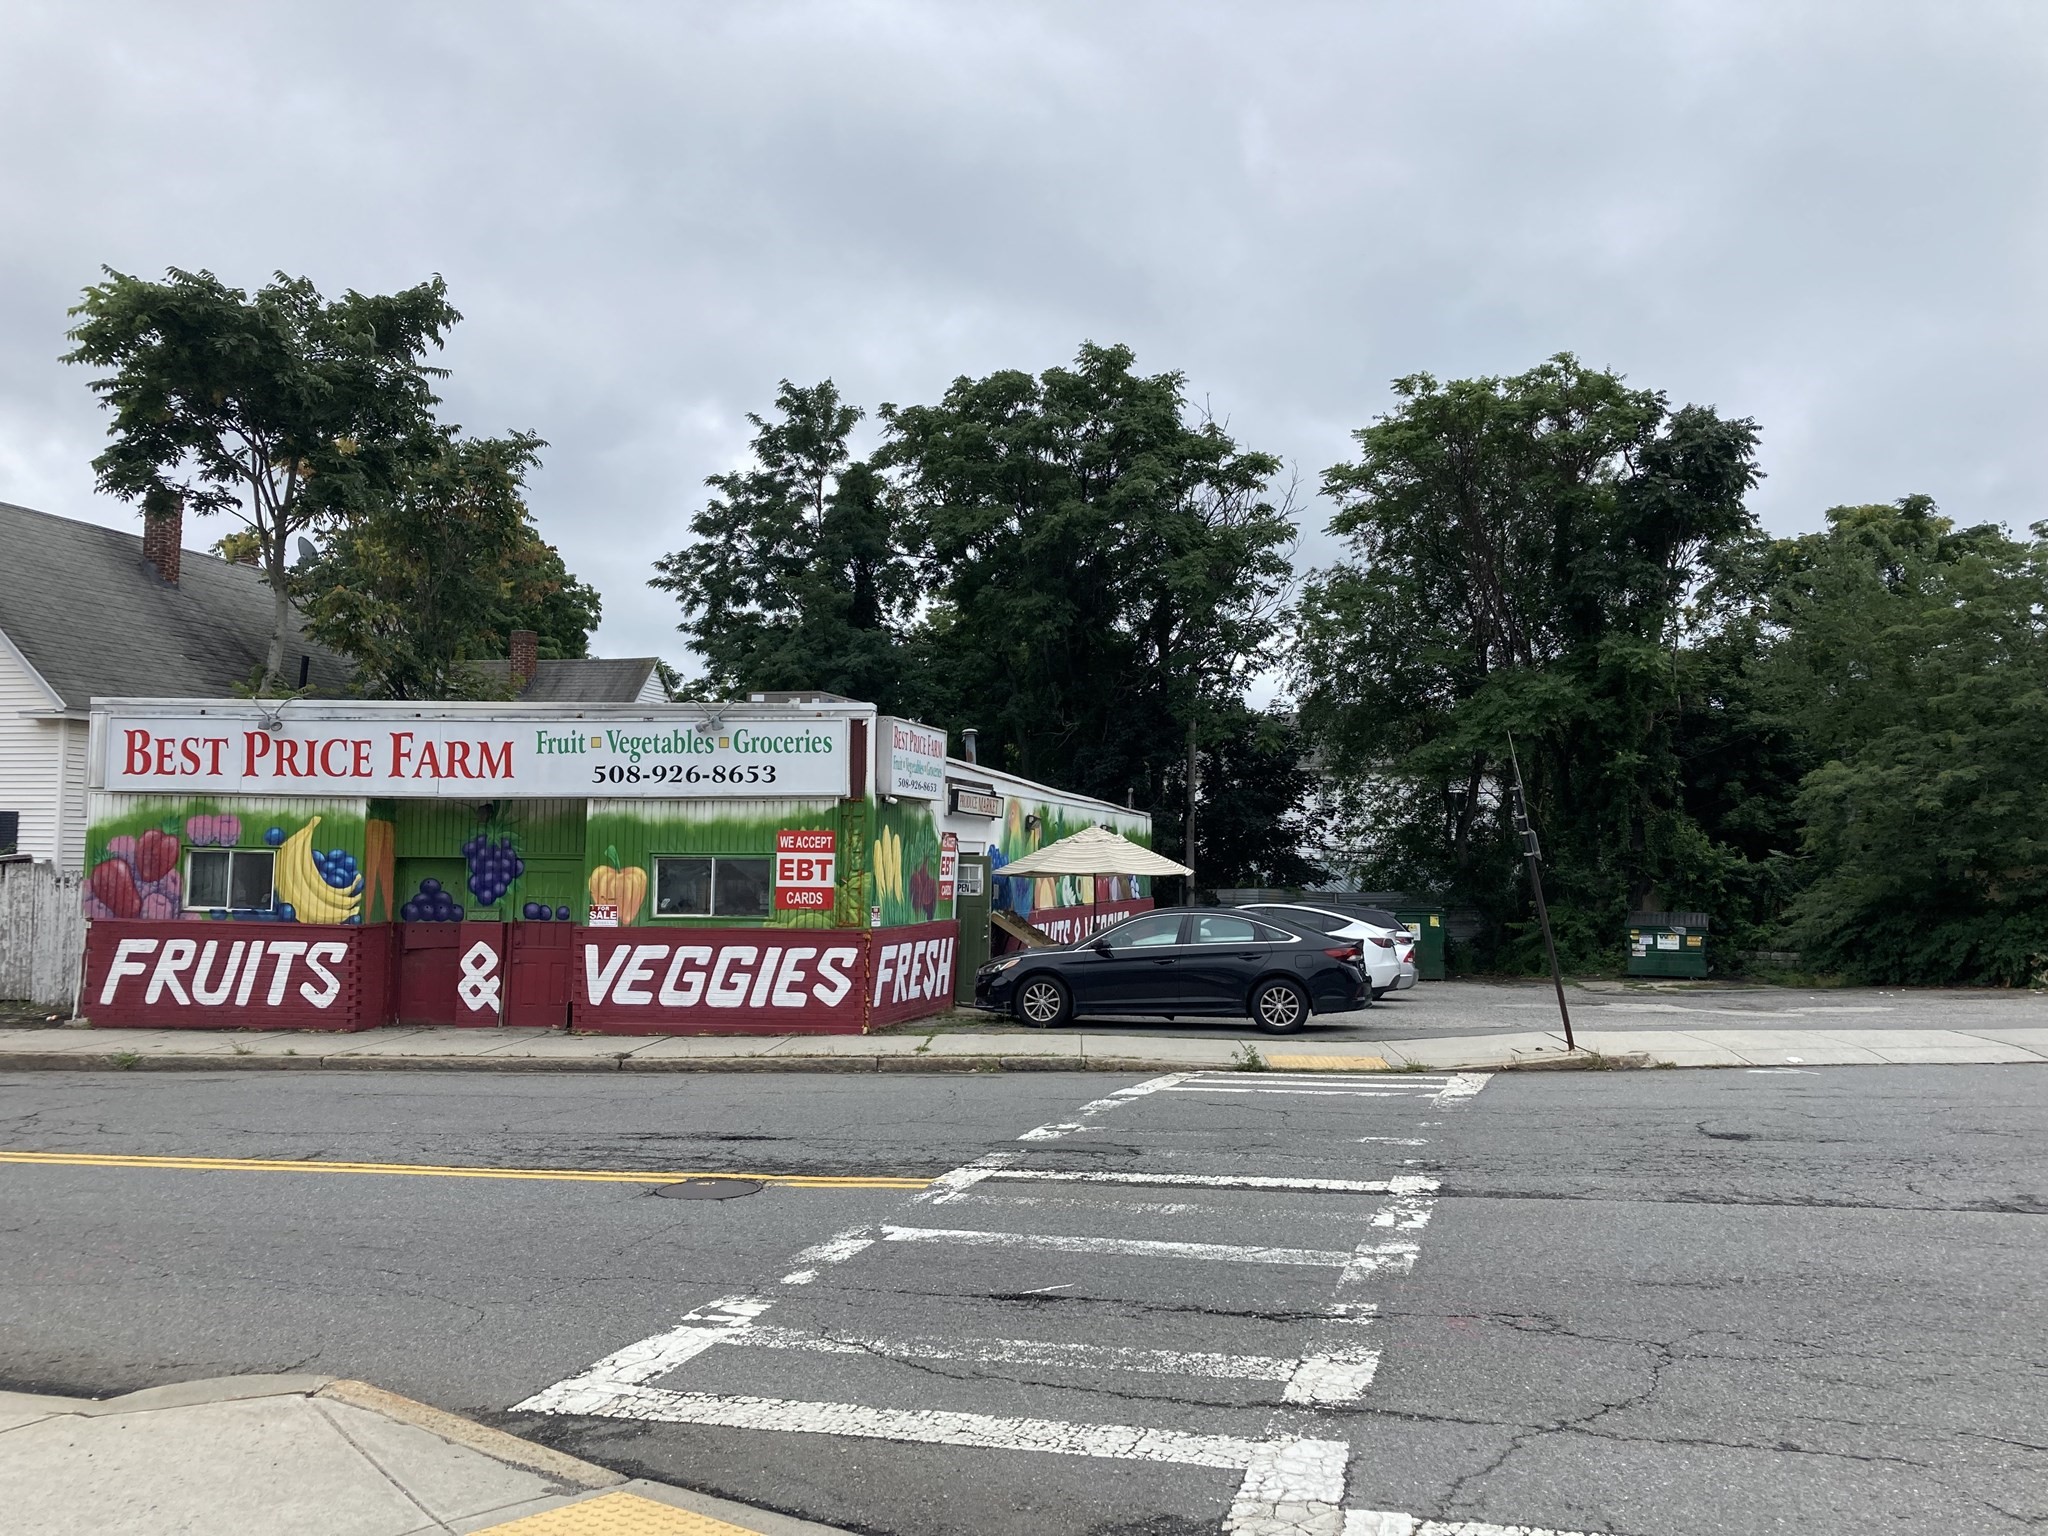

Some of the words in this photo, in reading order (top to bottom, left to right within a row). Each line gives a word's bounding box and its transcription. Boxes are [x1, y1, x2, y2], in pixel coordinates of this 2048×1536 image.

[122, 729, 229, 776] BEST
[242, 731, 373, 778] PRICE
[388, 732, 514, 779] FARM
[535, 729, 587, 755] Fruit
[606, 728, 715, 763] Vegetables
[733, 728, 833, 754] Groceries
[591, 764, 777, 784] 508-926-8653
[898, 777, 938, 793] 508-926-8653
[779, 835, 795, 849] WE
[795, 835, 833, 849] ACCEPT
[779, 858, 833, 882] EBT
[940, 856, 956, 877] EBT
[786, 891, 823, 905] CARDS
[957, 883, 970, 893] PEN
[589, 910, 617, 920] SALE
[99, 938, 349, 1009] FRUITS
[457, 940, 501, 1014] &
[584, 943, 859, 1008] VEGGIES
[872, 937, 956, 1007] FRESH
